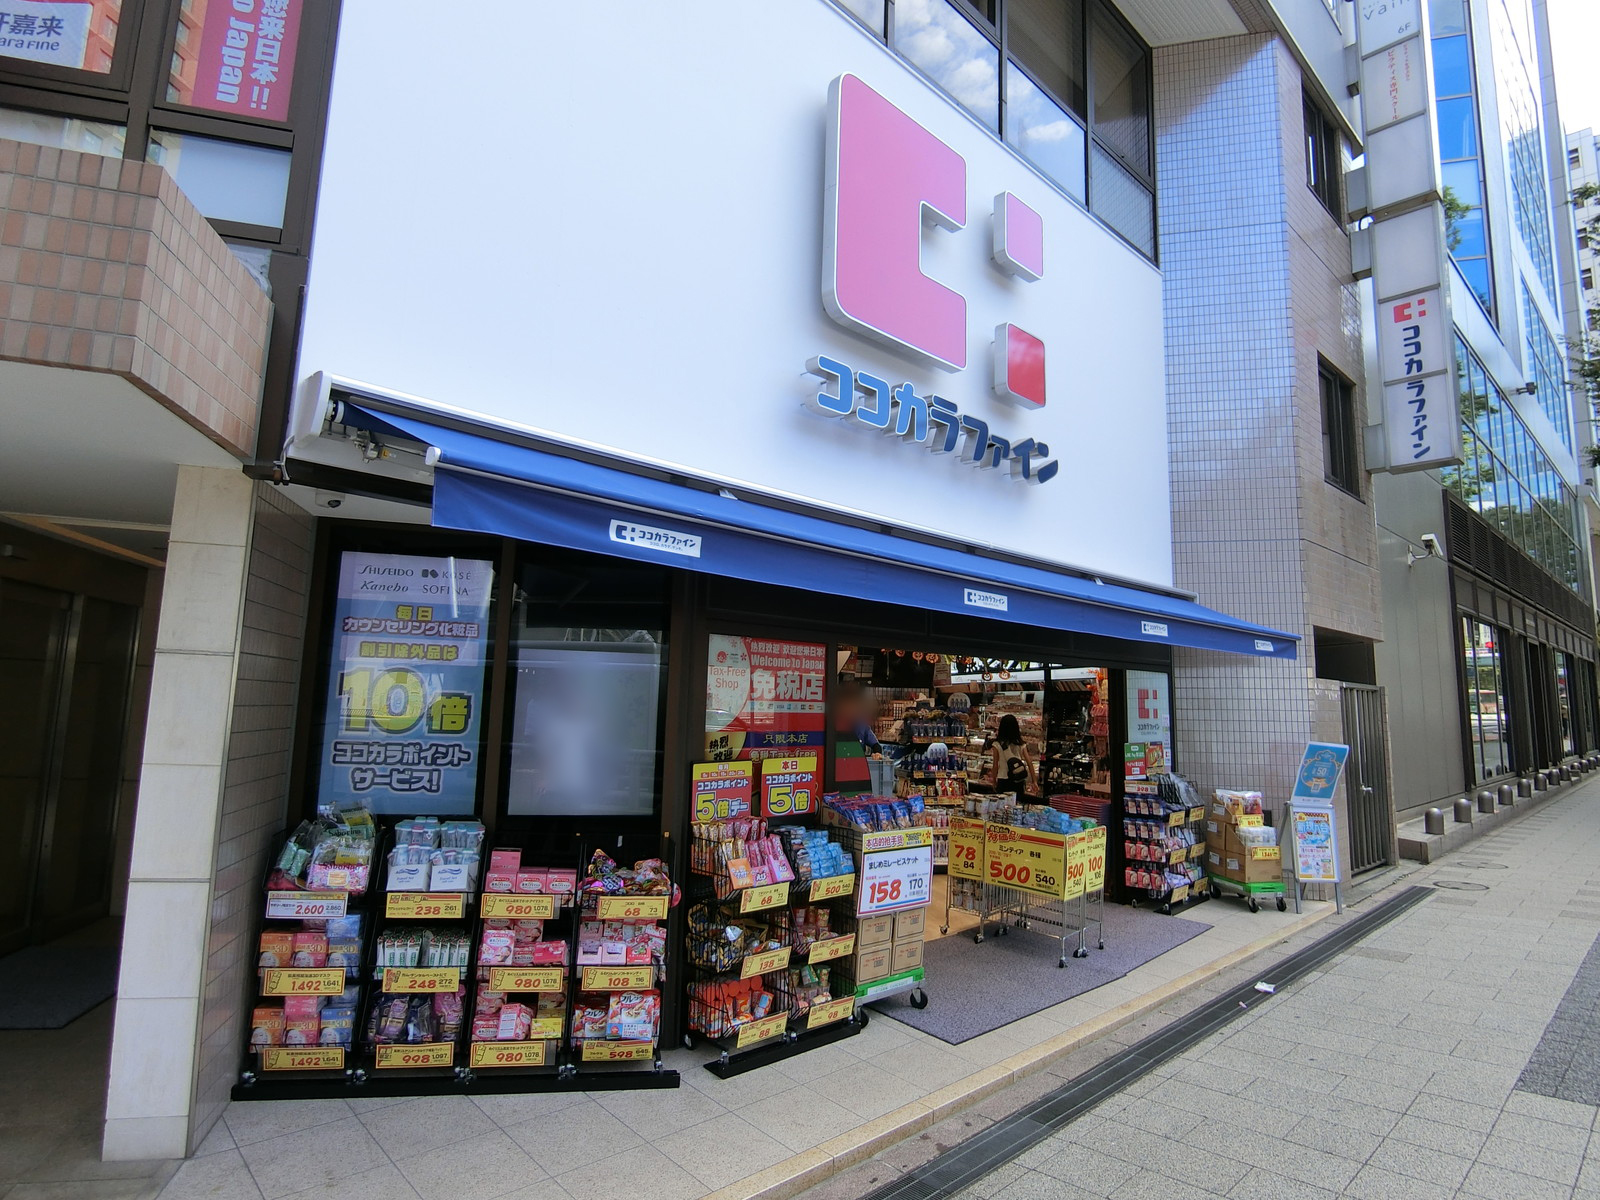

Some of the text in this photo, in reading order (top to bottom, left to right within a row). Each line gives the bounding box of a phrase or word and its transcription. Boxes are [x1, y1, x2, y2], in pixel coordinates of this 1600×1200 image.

[216, 16, 255, 104] Japan
[1402, 325, 1431, 459] ココカラファイン
[814, 354, 1059, 484] ココカラファイン
[638, 530, 697, 548] ココカラファイン
[359, 564, 414, 577] SHISEIDO
[360, 580, 469, 596] Kanebo SOFINA
[343, 617, 479, 638] カウンセリング化粧品
[360, 641, 459, 660] 割引除外品は
[751, 654, 791, 668] Welcome
[791, 657, 800, 669] to
[802, 658, 825, 670] Japan
[709, 664, 746, 677] Tax-Free
[715, 677, 739, 690] Shop
[751, 668, 825, 700] 免税店
[763, 733, 808, 744] 只限本店
[332, 740, 472, 766] ココカラポイント
[697, 779, 749, 791] ココカラポイント
[765, 773, 813, 785] ココカラポイント
[768, 784, 811, 815] 5倍
[954, 844, 976, 861] 78
[868, 856, 919, 870] まじめミレービスケット
[963, 860, 975, 869] 84
[1088, 855, 1103, 872] 100
[989, 860, 1031, 884] 500
[1068, 862, 1084, 880] 500
[1035, 873, 1056, 886] 540
[825, 885, 841, 895] 500
[869, 877, 924, 904] 158 170
[760, 895, 773, 905] 68
[414, 905, 441, 916] 238
[505, 904, 532, 915] 980
[624, 907, 641, 917] 68
[829, 947, 840, 957] 98
[408, 979, 437, 989] 248
[514, 978, 541, 988] 980
[607, 977, 630, 987] 108
[828, 1010, 839, 1019] 98
[402, 1054, 431, 1064] 998
[496, 1052, 523, 1062] 980
[609, 1050, 633, 1059] 598
